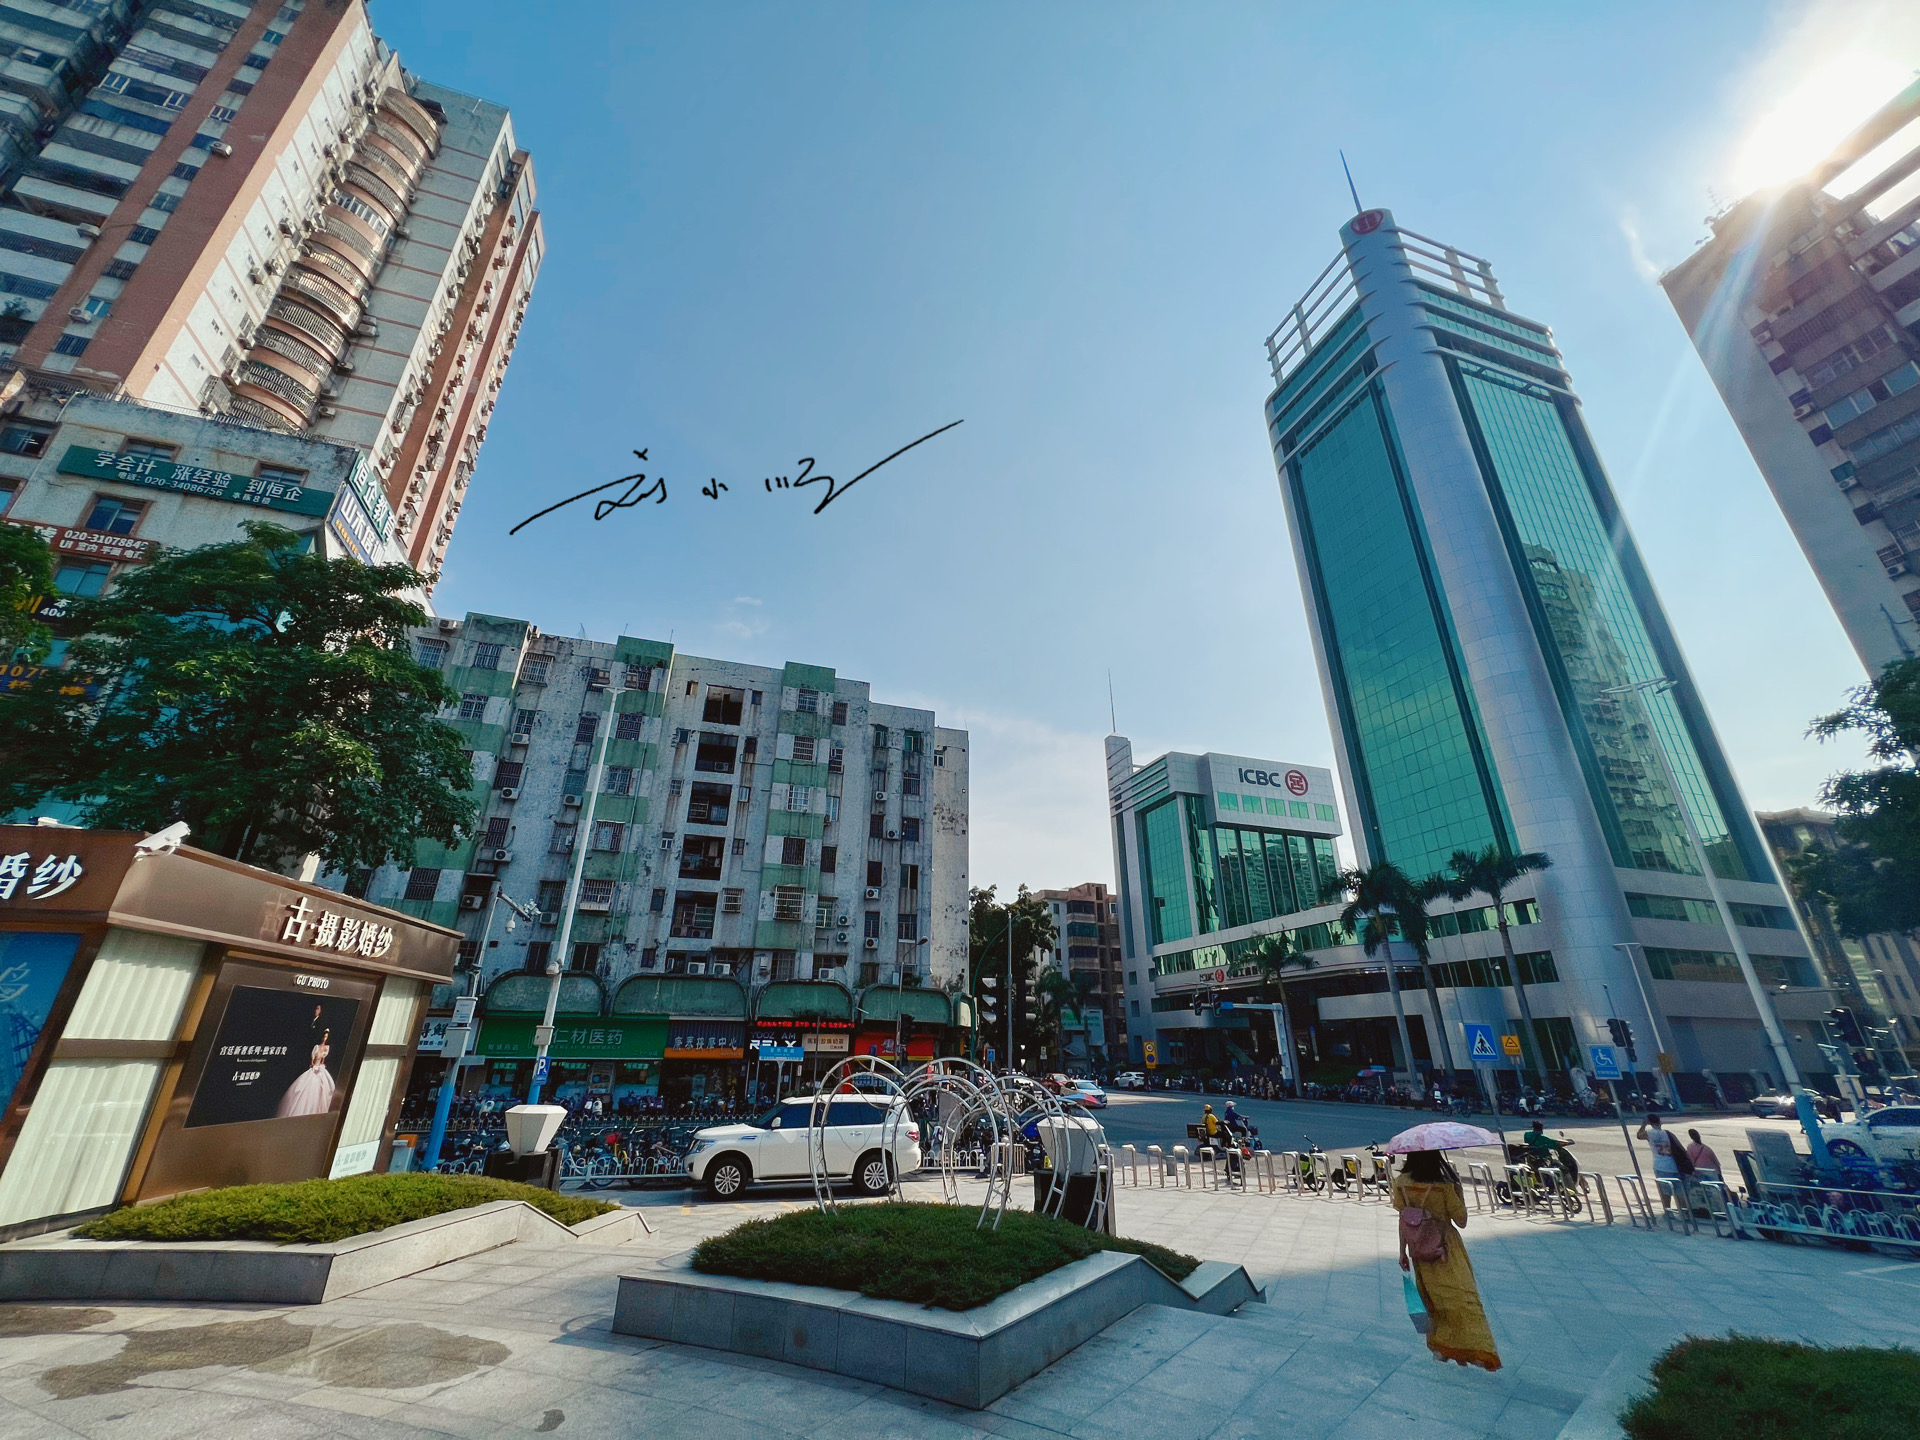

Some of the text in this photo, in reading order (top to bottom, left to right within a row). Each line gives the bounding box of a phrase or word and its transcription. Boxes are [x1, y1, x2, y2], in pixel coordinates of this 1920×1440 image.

[94, 452, 303, 502] 学会计 涨经验 到恒企
[354, 457, 398, 541] 恒企教育
[341, 492, 386, 567] 山木培训
[59, 540, 73, 549] UI
[1238, 768, 1281, 787] ICBC
[296, 975, 329, 989] GU PHOTO
[553, 1028, 624, 1045] 仁材医药
[537, 1058, 546, 1075] P
